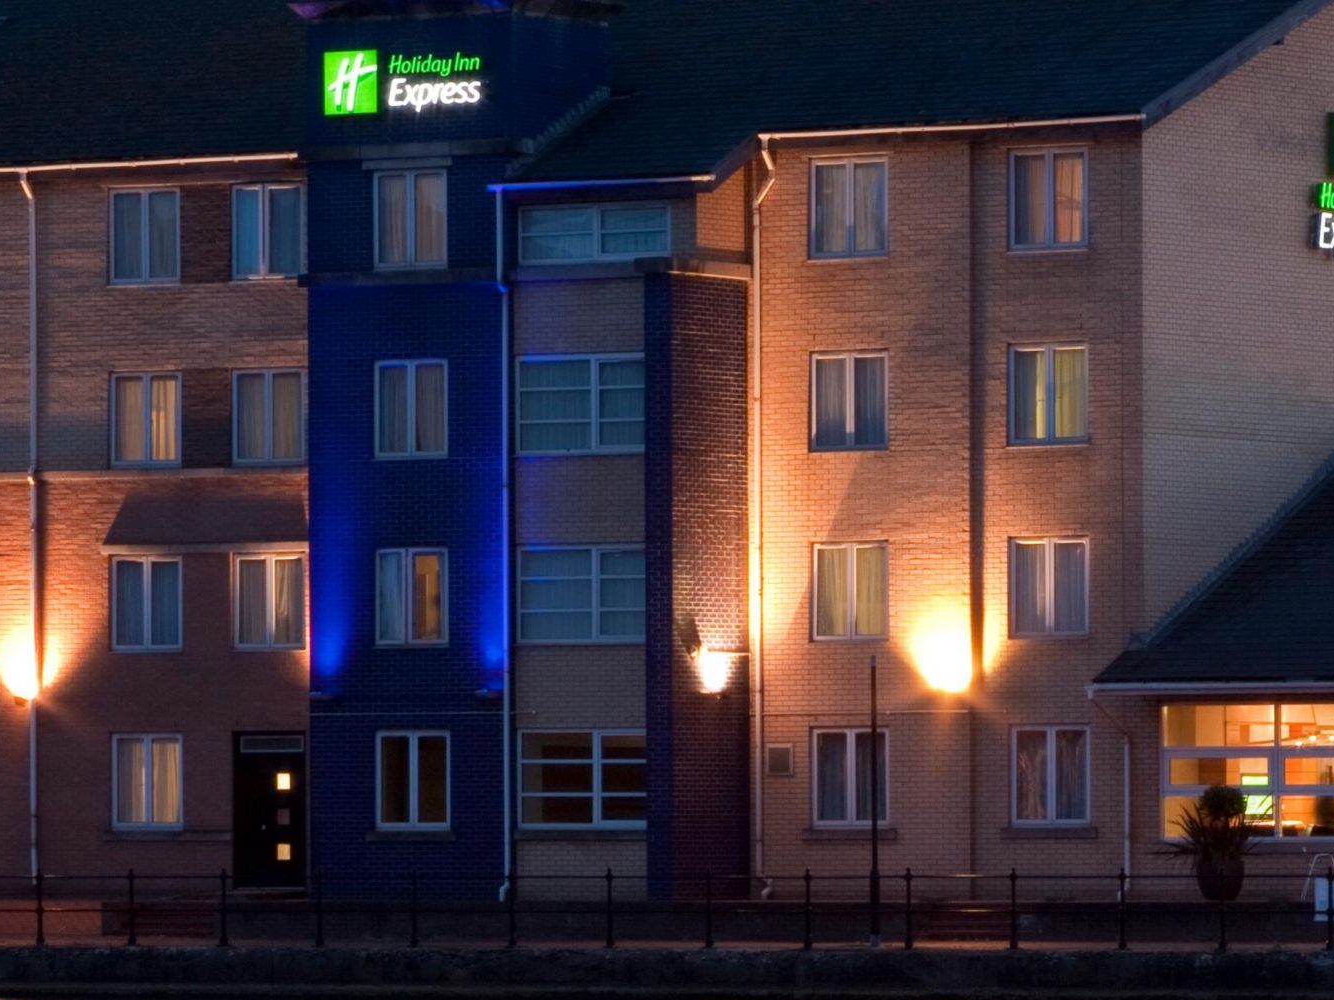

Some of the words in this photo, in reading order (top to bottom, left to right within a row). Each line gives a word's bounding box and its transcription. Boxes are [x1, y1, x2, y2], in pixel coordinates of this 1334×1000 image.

[389, 53, 451, 77] Holiday
[454, 52, 480, 71] Inn
[388, 78, 481, 112] Express
